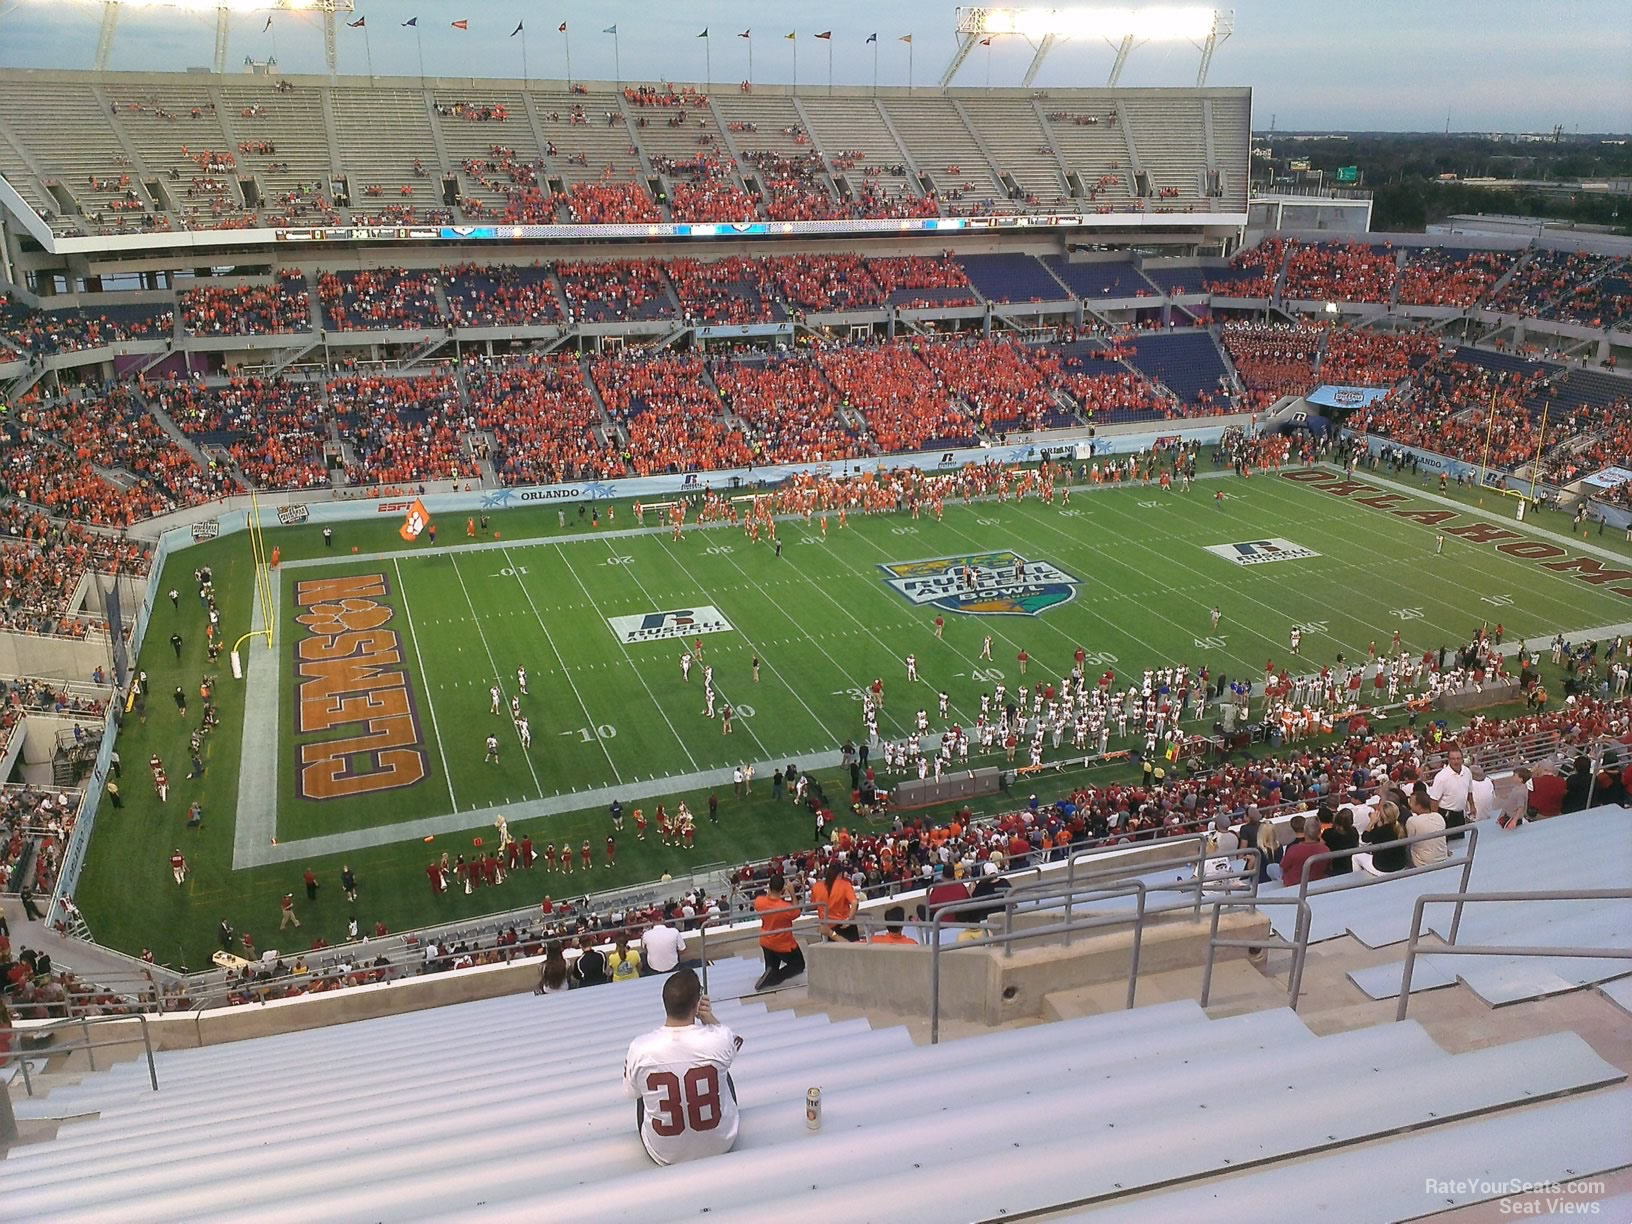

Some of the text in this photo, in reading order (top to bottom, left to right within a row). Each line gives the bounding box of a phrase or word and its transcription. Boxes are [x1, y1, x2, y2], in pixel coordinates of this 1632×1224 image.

[521, 488, 580, 501] ORLANDO
[891, 526, 919, 535] 50
[1279, 470, 1632, 599] OKLAHOM
[705, 545, 735, 555] 30
[1237, 548, 1311, 561] RUSSELL
[606, 555, 635, 566] 20
[500, 566, 530, 577] 10
[959, 585, 1045, 601] BOWL
[1389, 608, 1424, 620] 20
[627, 620, 726, 638] RUSSELL
[1194, 636, 1227, 649] 40
[1085, 651, 1118, 665] 50
[971, 667, 1006, 683] 40
[577, 724, 617, 743] 10
[646, 1064, 722, 1137] 38
